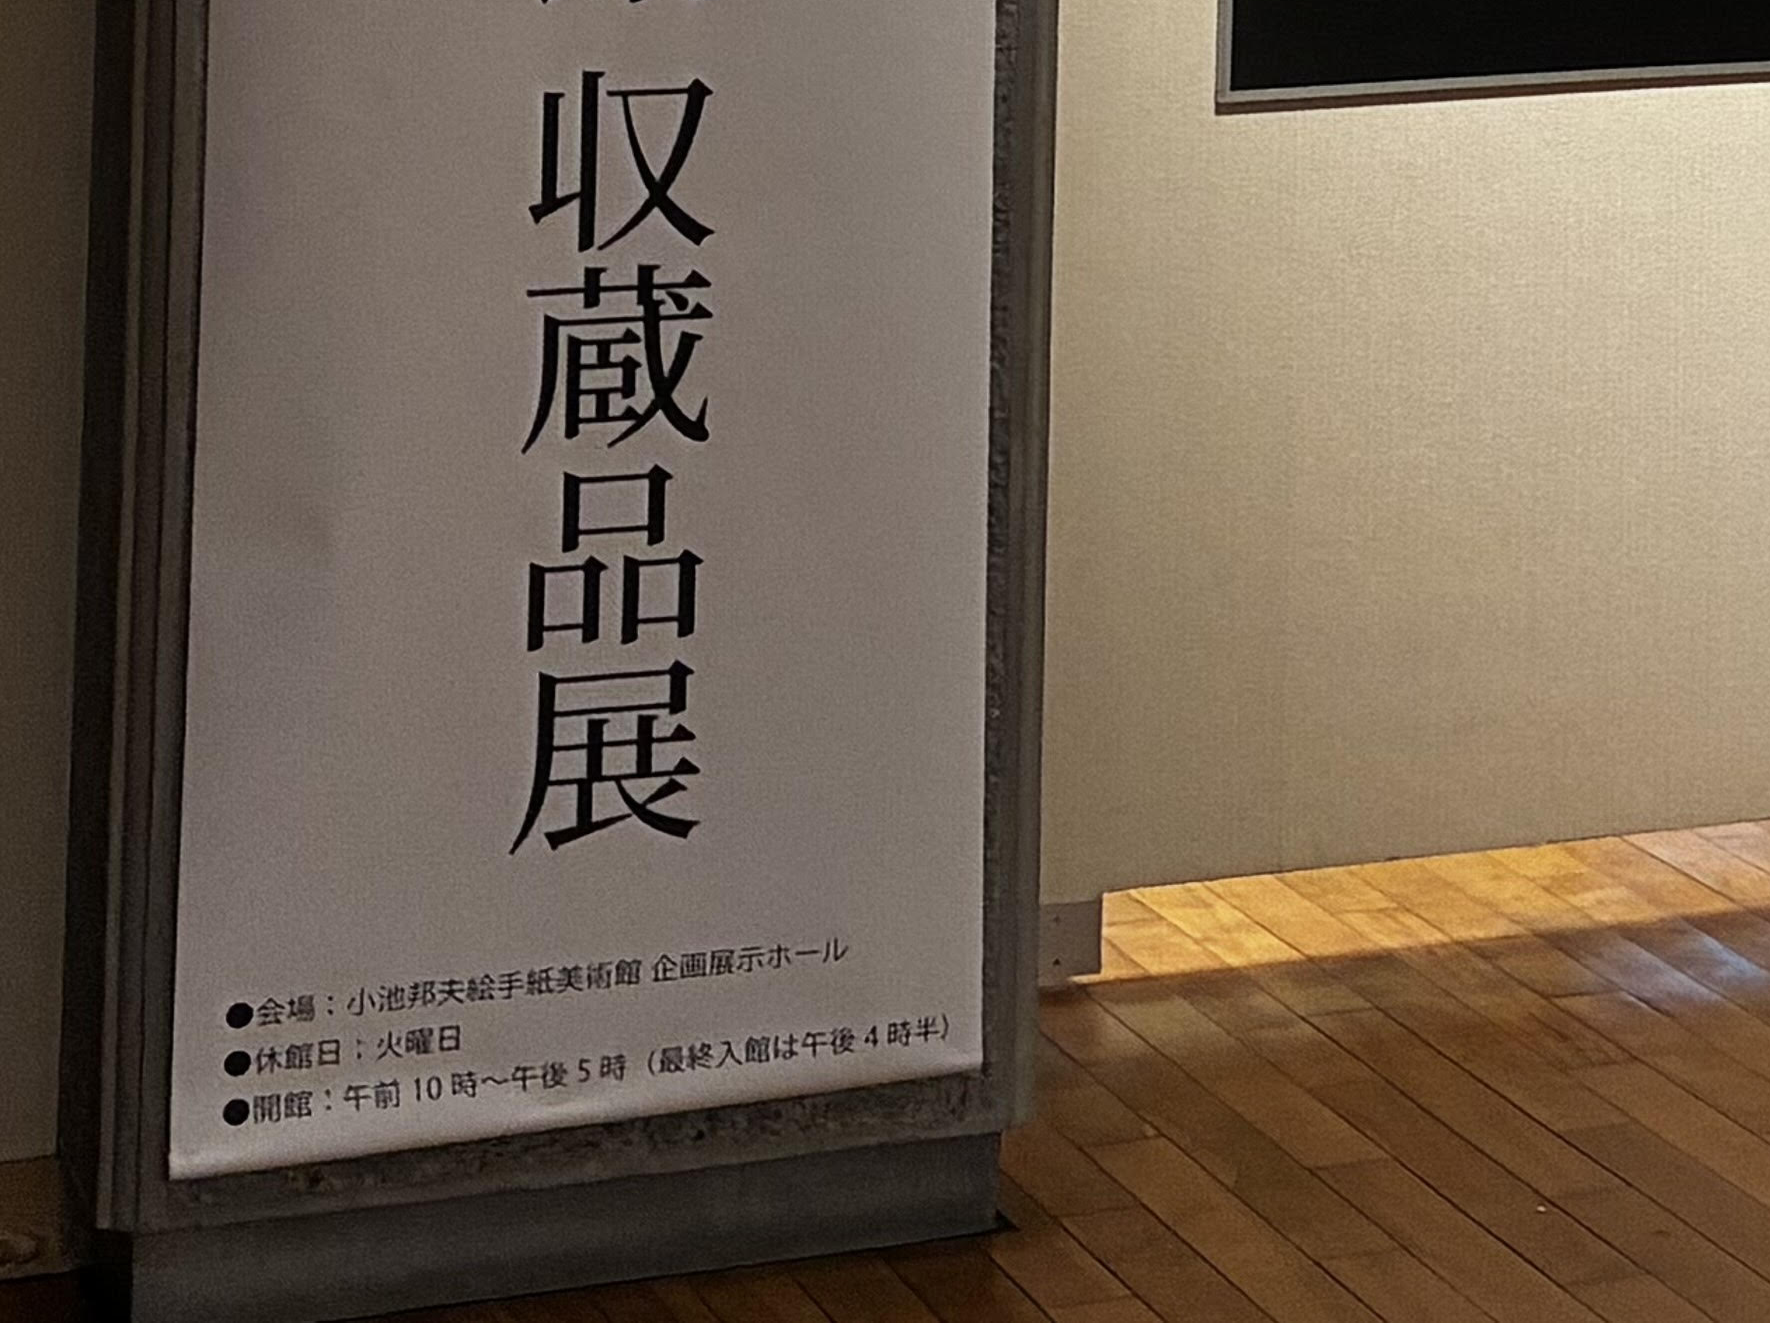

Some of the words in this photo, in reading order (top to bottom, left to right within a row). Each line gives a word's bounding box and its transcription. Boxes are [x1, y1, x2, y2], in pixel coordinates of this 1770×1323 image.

[508, 69, 716, 856] 収蔵品展
[651, 938, 849, 983] 企画展示ホール
